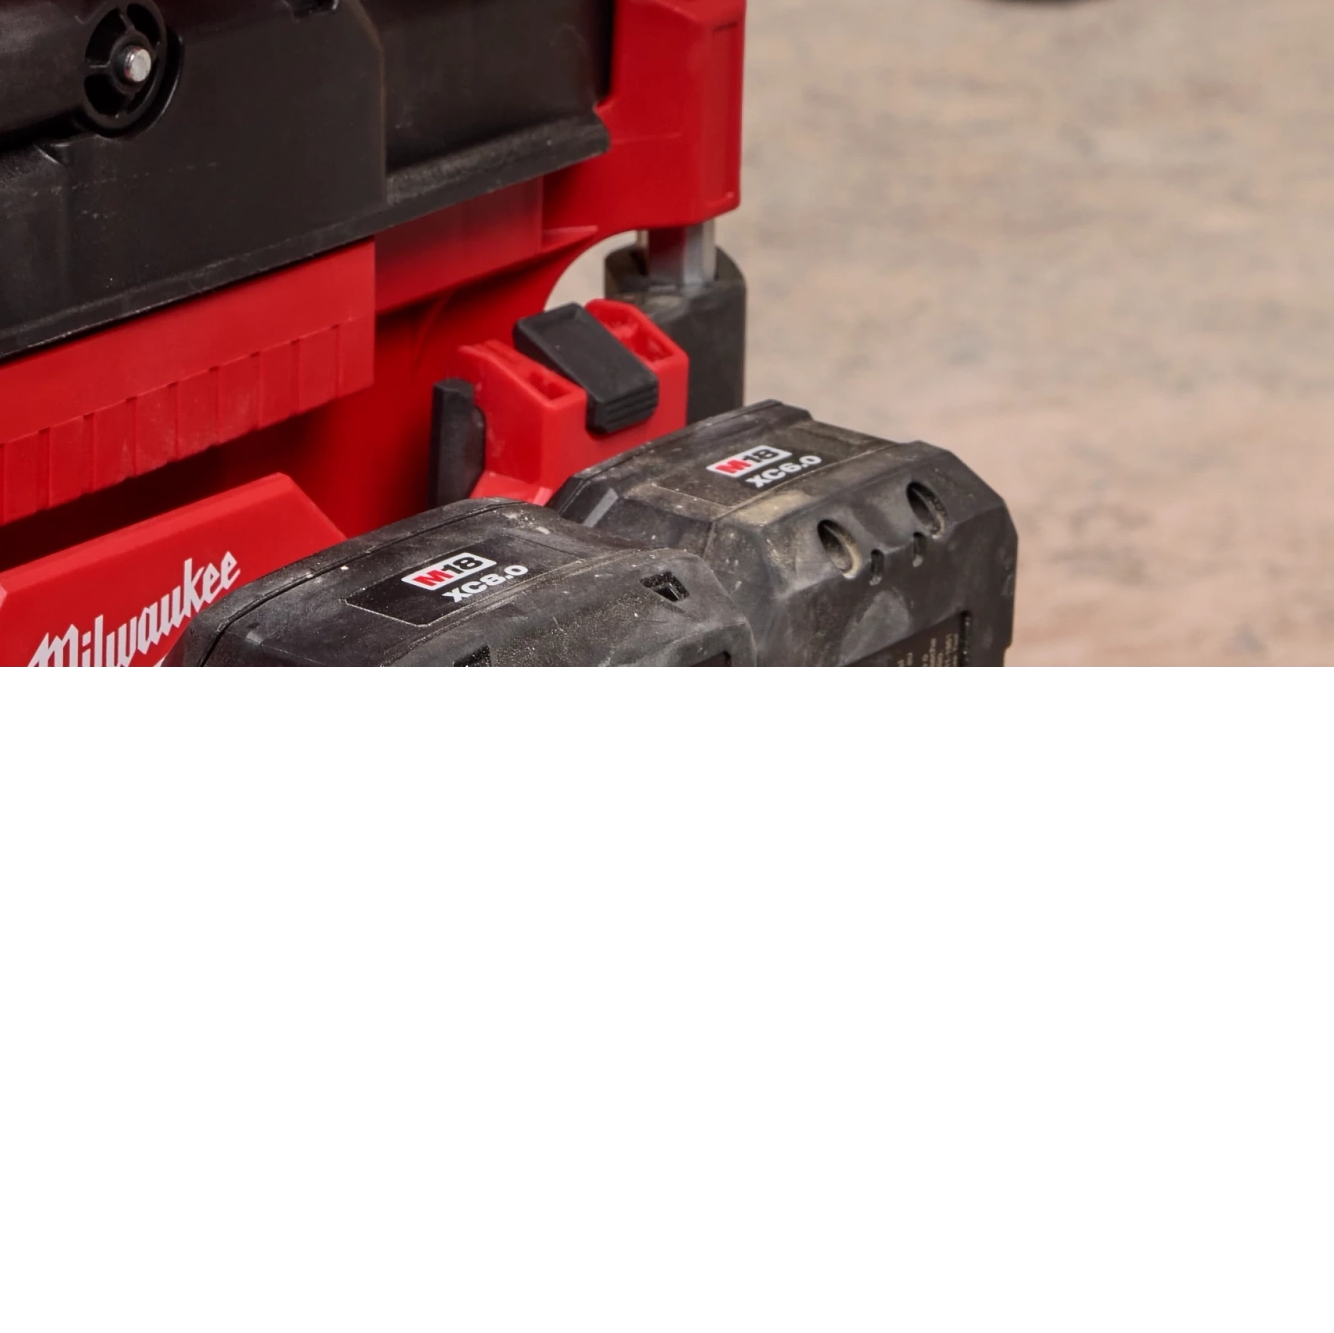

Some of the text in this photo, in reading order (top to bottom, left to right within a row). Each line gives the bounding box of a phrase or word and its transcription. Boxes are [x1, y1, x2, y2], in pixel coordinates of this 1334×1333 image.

[714, 448, 780, 475] M18
[745, 455, 822, 489] XC6.0
[411, 556, 484, 587] M18
[442, 565, 529, 603] XC8.0
